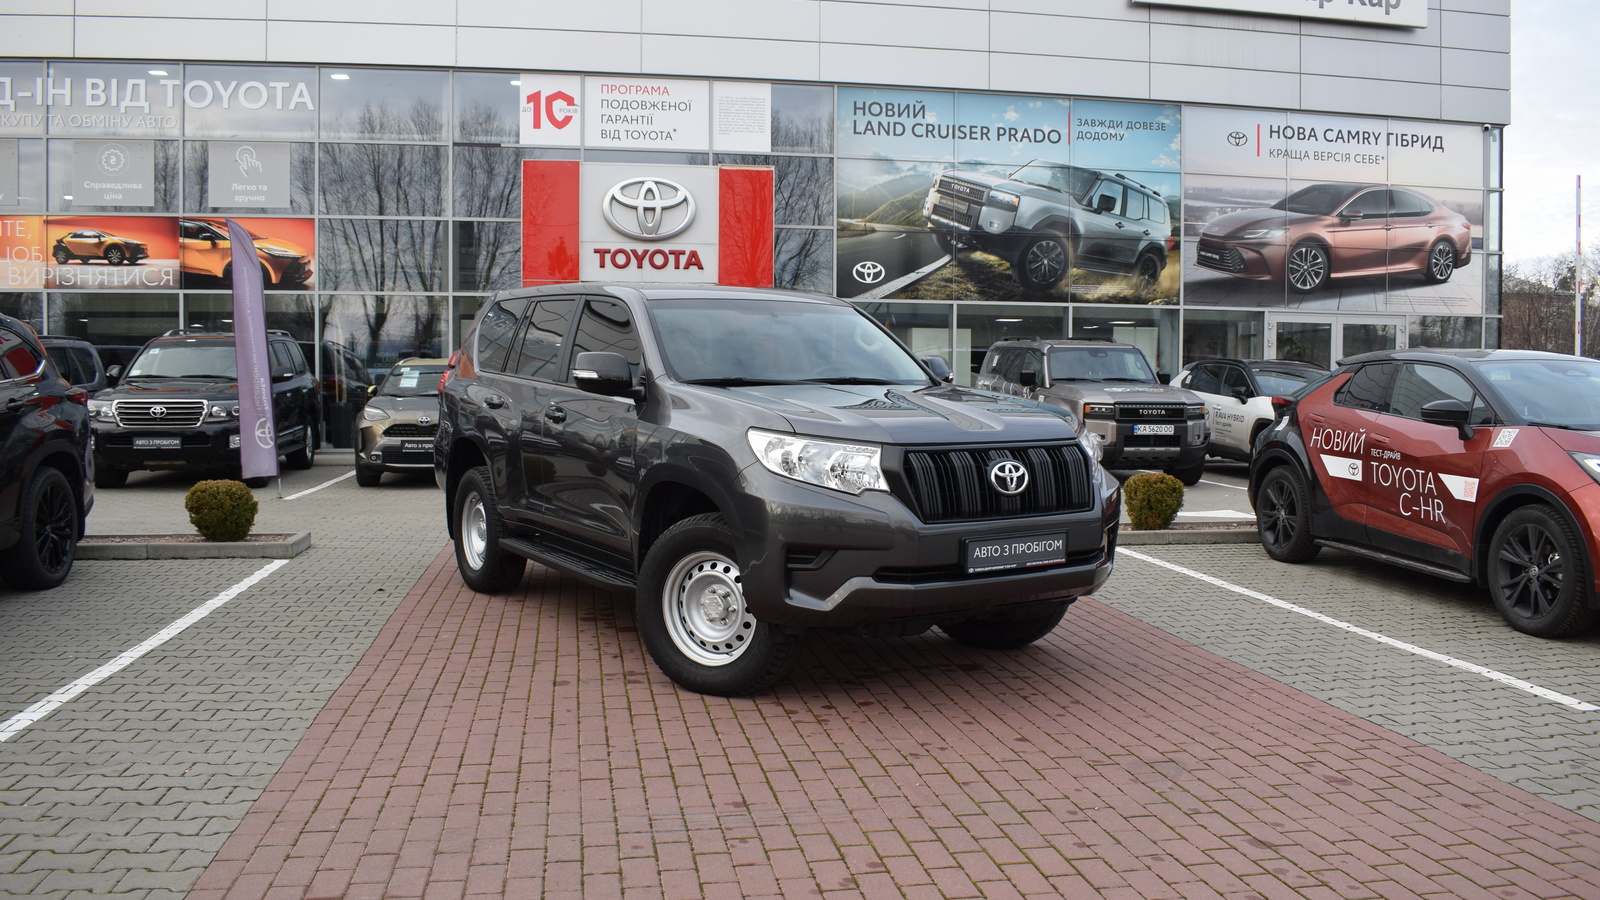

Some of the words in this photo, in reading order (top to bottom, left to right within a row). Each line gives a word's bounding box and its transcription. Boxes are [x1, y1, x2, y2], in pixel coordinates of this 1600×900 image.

[85, 78, 151, 114] ВІД
[160, 79, 315, 111] TOYOTA
[600, 84, 670, 97] ПРОГРАМА
[559, 107, 578, 115] РОКІВ
[600, 98, 692, 113] ПОДОВЖЕНОЇ
[853, 99, 926, 120] НОВИЙ
[48, 114, 66, 128] ТА
[69, 115, 133, 128] ОБМІНУ
[136, 115, 178, 129] АВТО
[600, 113, 654, 126] ГАРАНТІЇ
[1076, 117, 1124, 130] ЗАВЖДИ
[1126, 119, 1167, 133] ДОВЕЗЕ
[600, 129, 621, 141] ВІД
[853, 119, 906, 137] LAND
[911, 122, 991, 142] CRUISER
[996, 126, 1062, 145] PRADO
[1076, 130, 1126, 143] ДОДОМУ
[1269, 125, 1319, 142] НОВА
[1323, 128, 1382, 146] CAMRY
[1386, 132, 1445, 153] ГІБРИД
[1269, 148, 1311, 162] КРАЩА
[1313, 151, 1351, 163] ВЕРСІЯ
[84, 181, 143, 191] Справедлива
[231, 182, 255, 192] Легко
[257, 183, 268, 192] та
[951, 183, 970, 194] TOYOTA
[104, 191, 123, 201] ціна
[234, 193, 265, 203] зручно
[0, 220, 32, 239] ТЕ,
[593, 247, 705, 270] TOYOTA
[8, 267, 174, 287] ВИРІЗНЯТИСЯ
[1227, 412, 1245, 423] HYBRID
[1137, 425, 1147, 433] KA
[1148, 425, 1163, 433] 5620
[1310, 427, 1366, 454] НОВИЙ
[1370, 449, 1401, 461] ТЕСТ-ДРАЙВ
[1370, 461, 1437, 495] TOYOTA
[1399, 492, 1446, 523] C-HR
[973, 545, 1001, 559] АВТО
[1003, 545, 1010, 556] З
[1011, 539, 1063, 555] ПРОБІГОМ
